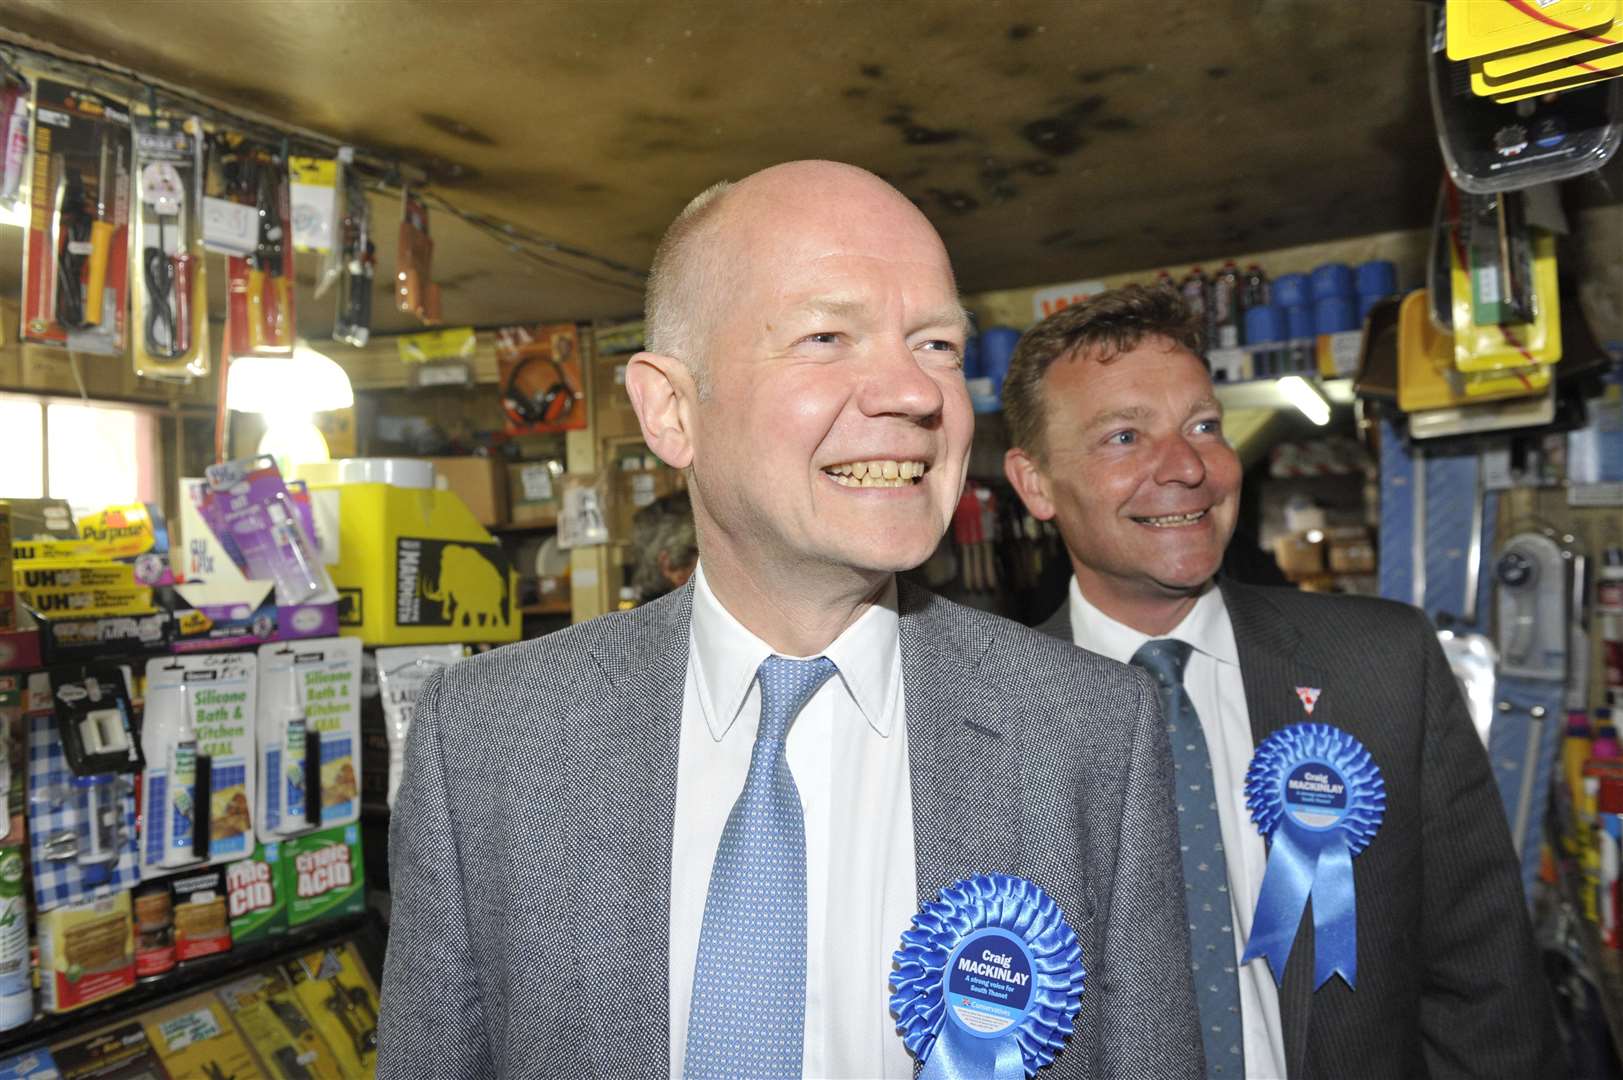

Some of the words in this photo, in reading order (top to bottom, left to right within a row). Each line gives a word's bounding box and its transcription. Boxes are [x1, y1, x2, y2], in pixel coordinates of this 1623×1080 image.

[305, 671, 352, 686] Silicone
[194, 688, 247, 706] Silicone
[307, 686, 336, 701] Bath
[196, 707, 229, 723] Bath
[234, 705, 242, 719] &
[194, 723, 245, 740] Kitchen
[1288, 779, 1345, 795] MACKINLAY
[297, 862, 352, 897] ACID
[229, 882, 273, 918] CID
[982, 949, 1013, 969] Craig
[958, 957, 1030, 986] MACKINLAY
[970, 976, 990, 988] strong
